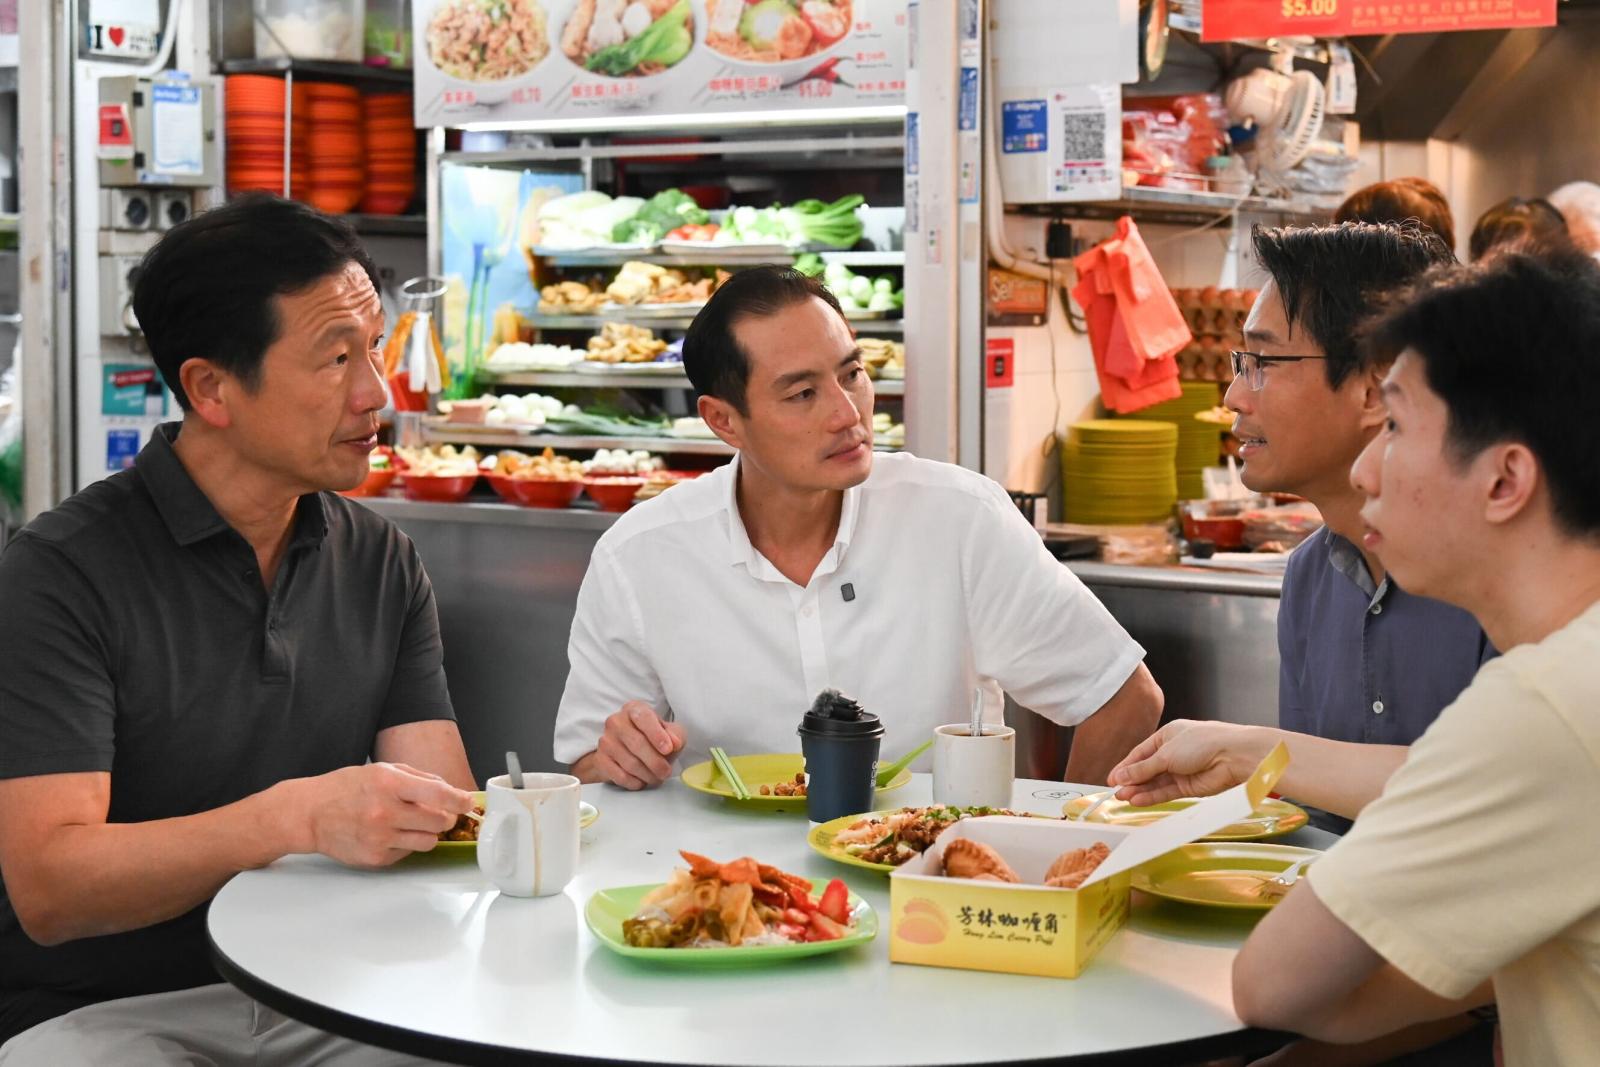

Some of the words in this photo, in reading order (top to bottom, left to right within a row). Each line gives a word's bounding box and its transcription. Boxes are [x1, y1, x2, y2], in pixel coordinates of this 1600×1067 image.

[1281, 0, 1337, 18] $5.00
[956, 906, 1059, 934] 芳林咖喱角
